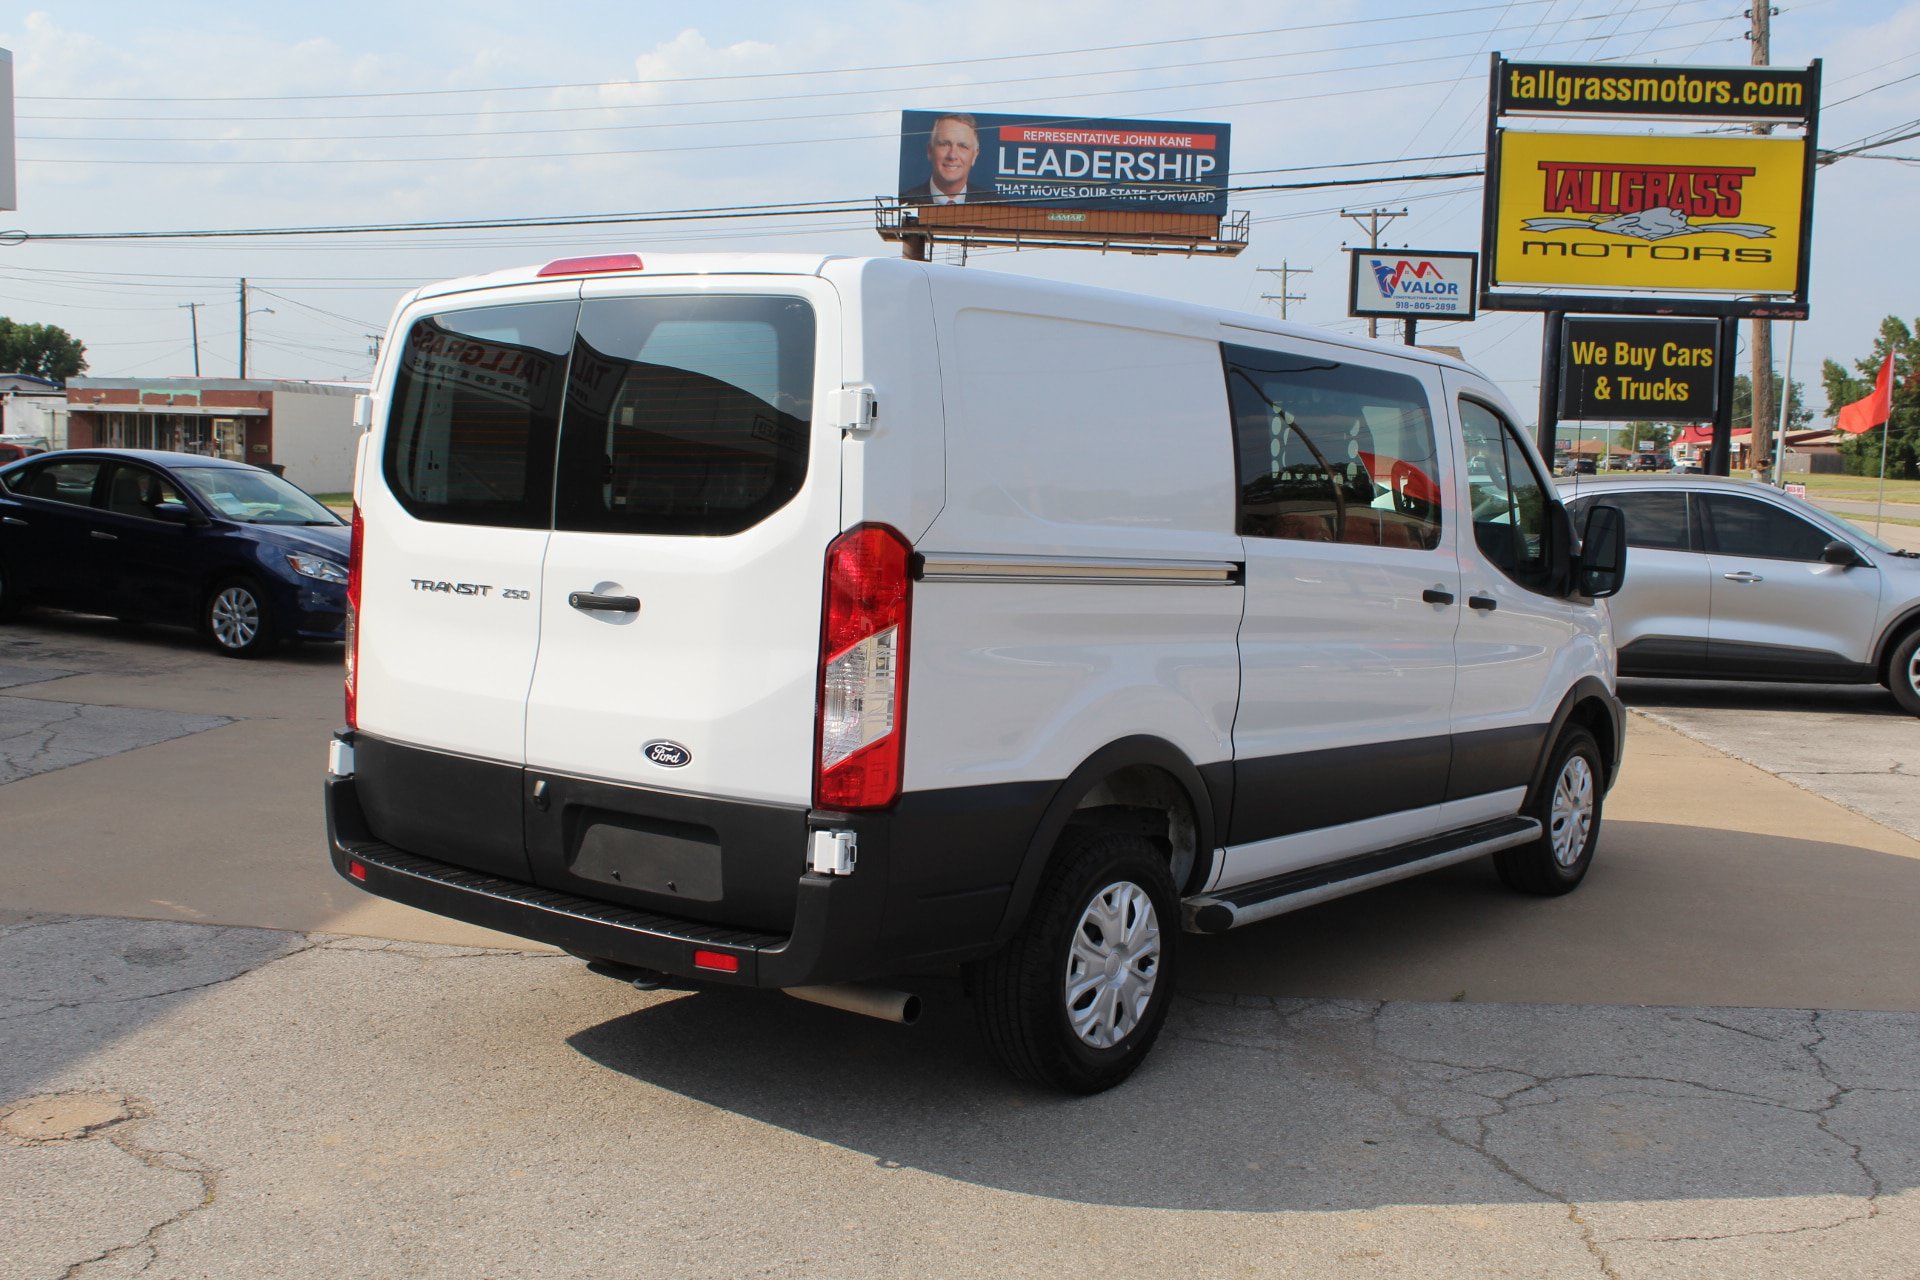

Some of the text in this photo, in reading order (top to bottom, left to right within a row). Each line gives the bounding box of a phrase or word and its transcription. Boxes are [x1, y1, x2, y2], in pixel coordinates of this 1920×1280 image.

[1510, 69, 1802, 106] tallgrassmotors.com
[1023, 130, 1192, 147] REPRESENTATIVE JOHN KANE
[998, 146, 1216, 183] LEADERSHIP
[995, 183, 1216, 203] THAT MOVES OUR STATE FORWARD
[1537, 160, 1756, 218] TALLGRASS
[1401, 280, 1458, 295] VALOR
[1395, 301, 1457, 311] 918-805-2898
[1572, 341, 1713, 371] We Buy Cars
[1594, 376, 1689, 401] & Trucks
[411, 579, 530, 600] TRANSIT 250
[651, 745, 681, 764] Ford
